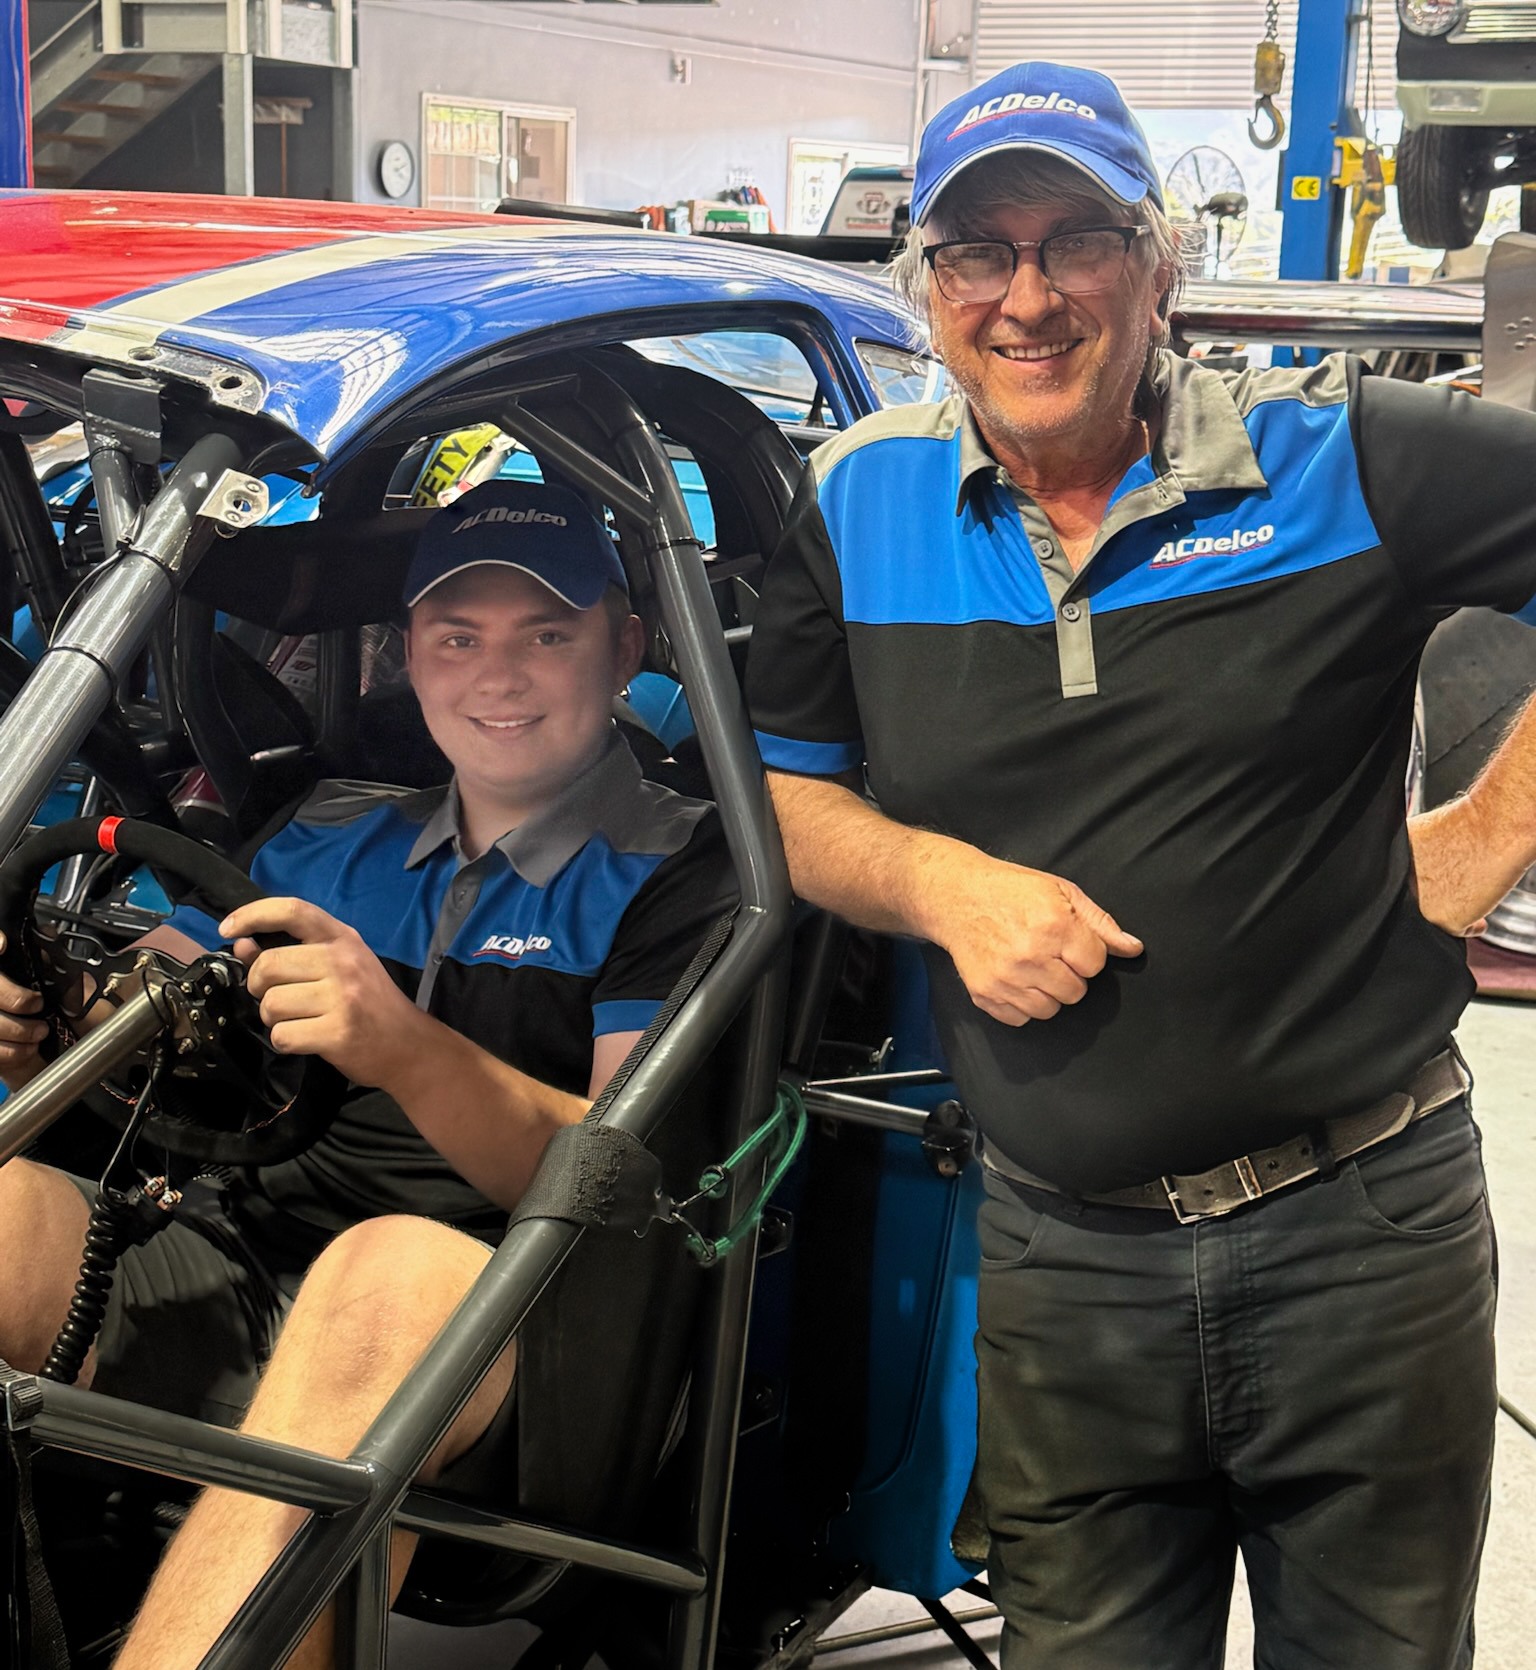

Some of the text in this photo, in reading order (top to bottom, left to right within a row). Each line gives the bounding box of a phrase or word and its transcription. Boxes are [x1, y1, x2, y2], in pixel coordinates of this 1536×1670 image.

[953, 92, 1097, 132] ACDelco
[1293, 180, 1318, 198] CE
[451, 507, 568, 534] ACDelco
[1152, 524, 1274, 563] ACDelco
